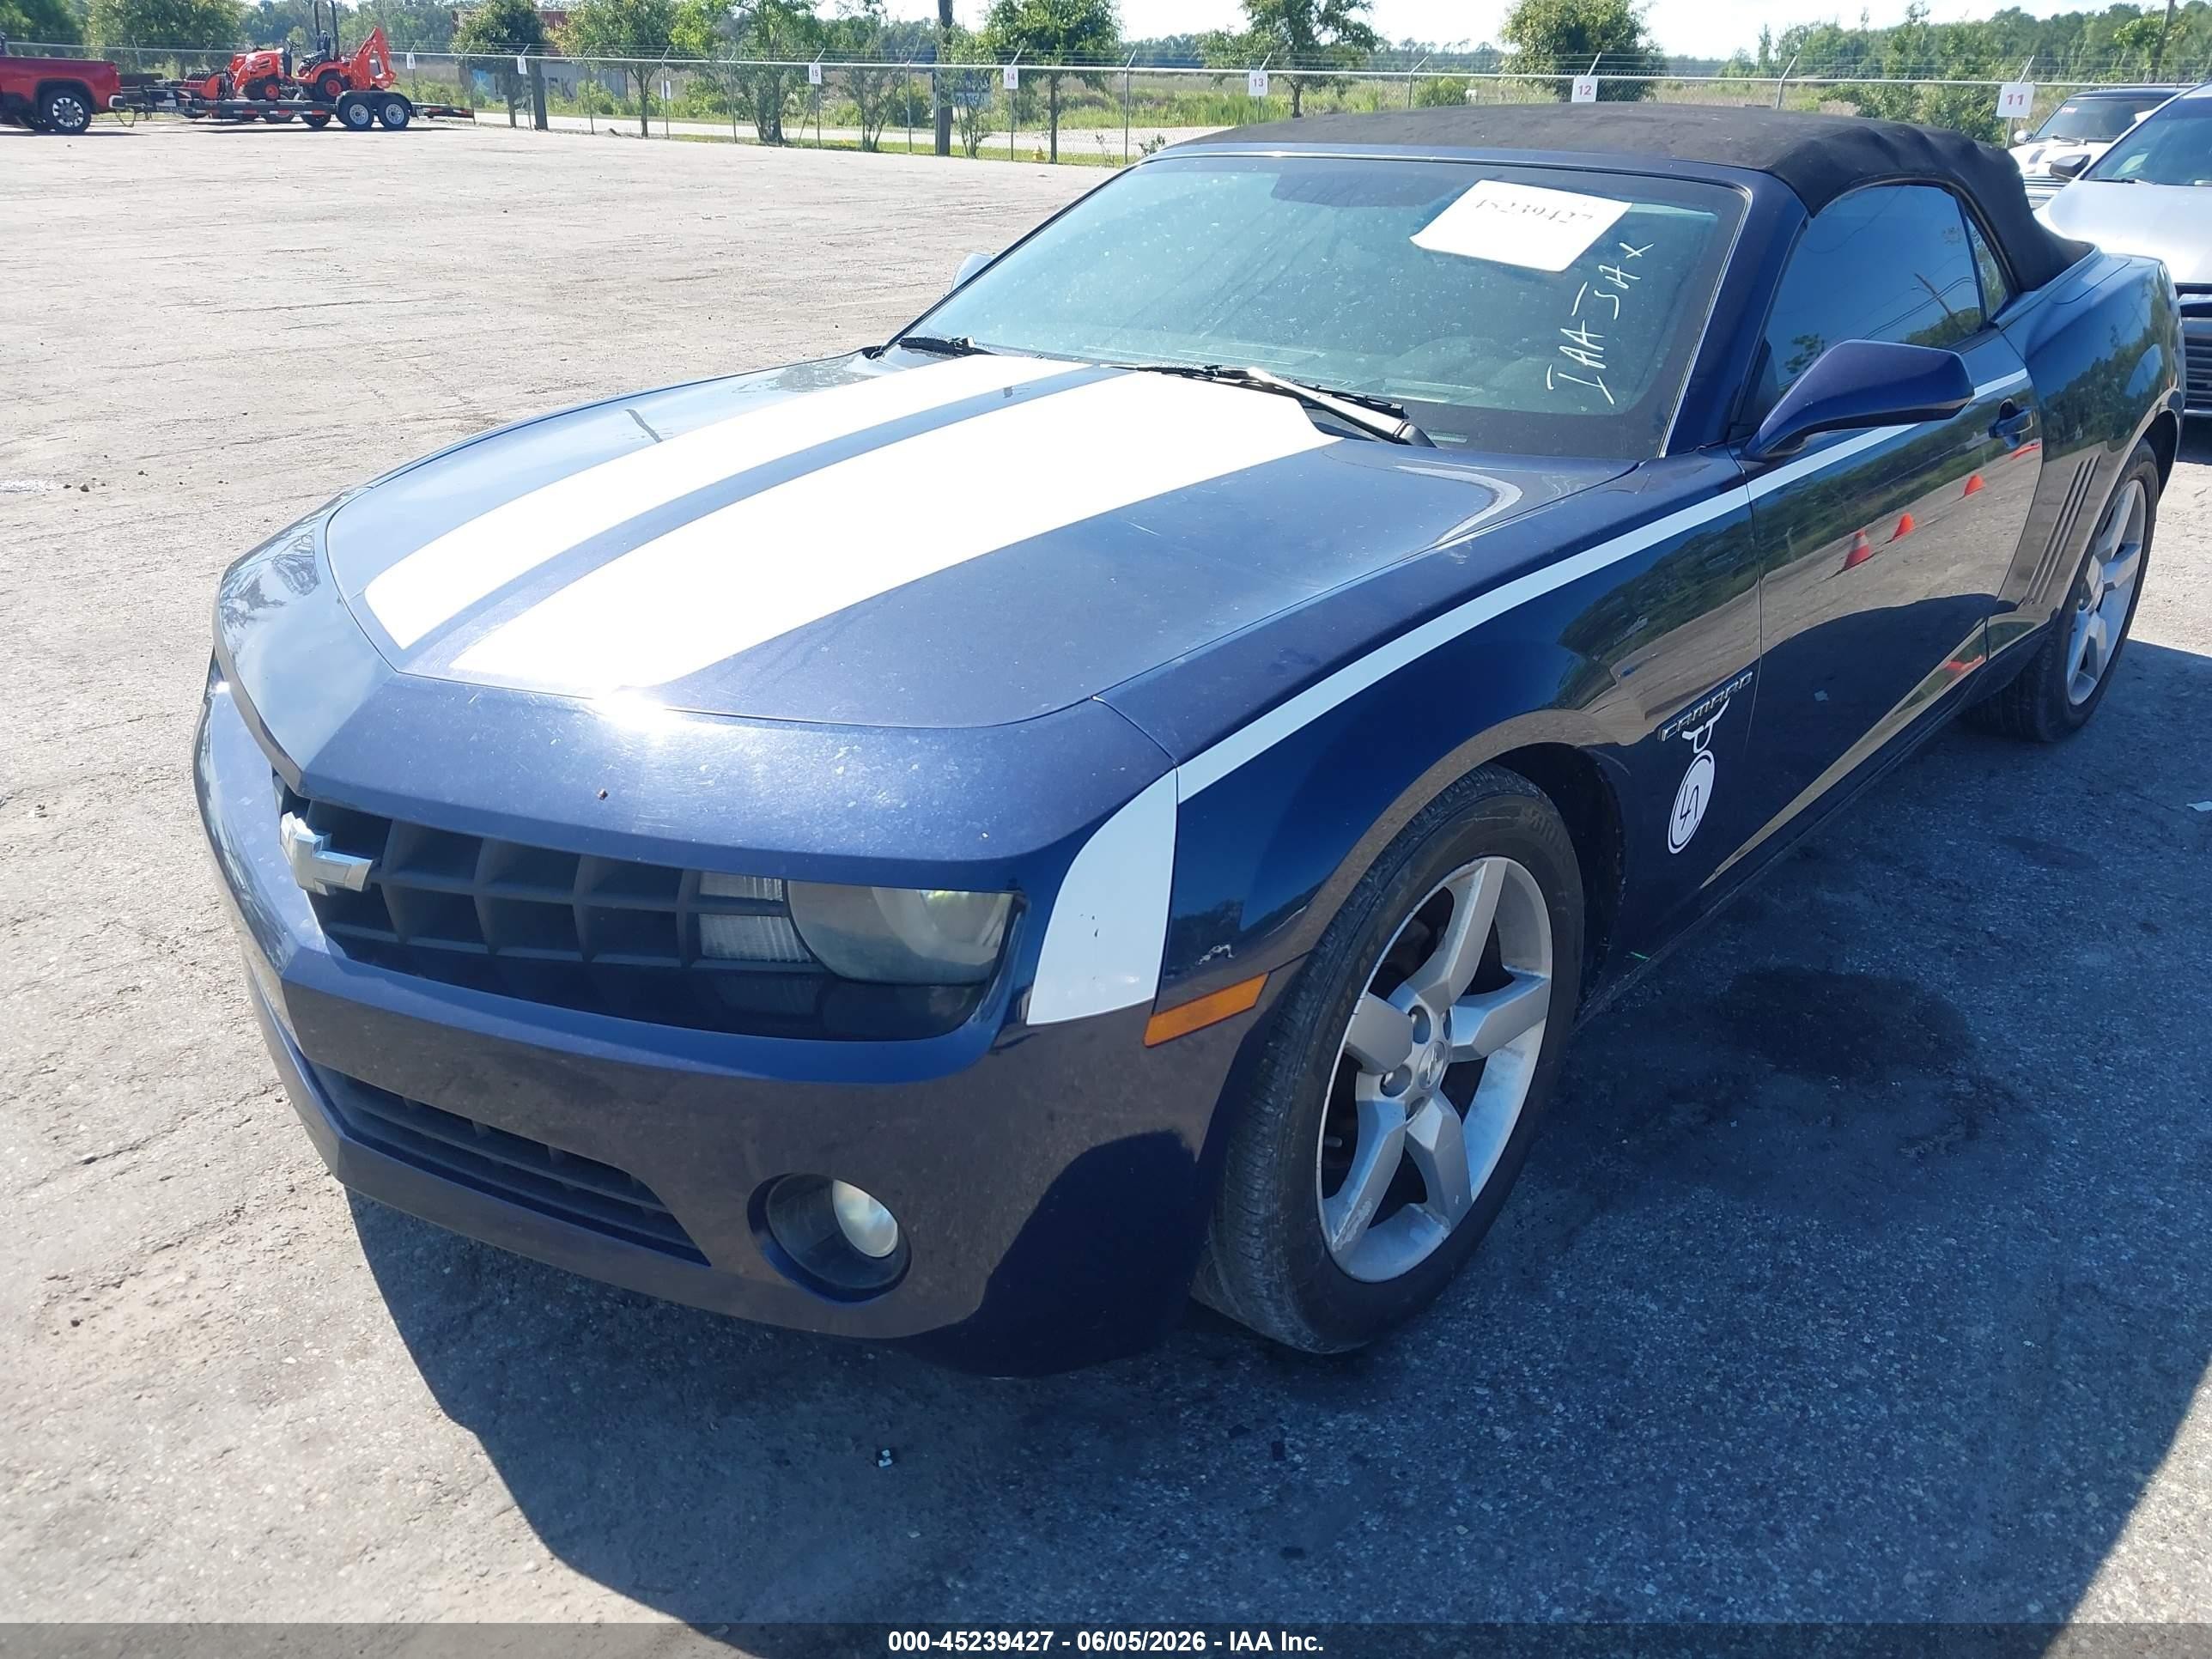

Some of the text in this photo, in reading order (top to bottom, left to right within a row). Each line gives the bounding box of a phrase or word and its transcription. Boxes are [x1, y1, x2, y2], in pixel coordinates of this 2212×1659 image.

[1006, 72, 1016, 82] 14
[1253, 77, 1264, 88] 13
[1578, 84, 1592, 96] 12
[2007, 93, 2025, 106] 11
[1661, 672, 1753, 742] CAMARO
